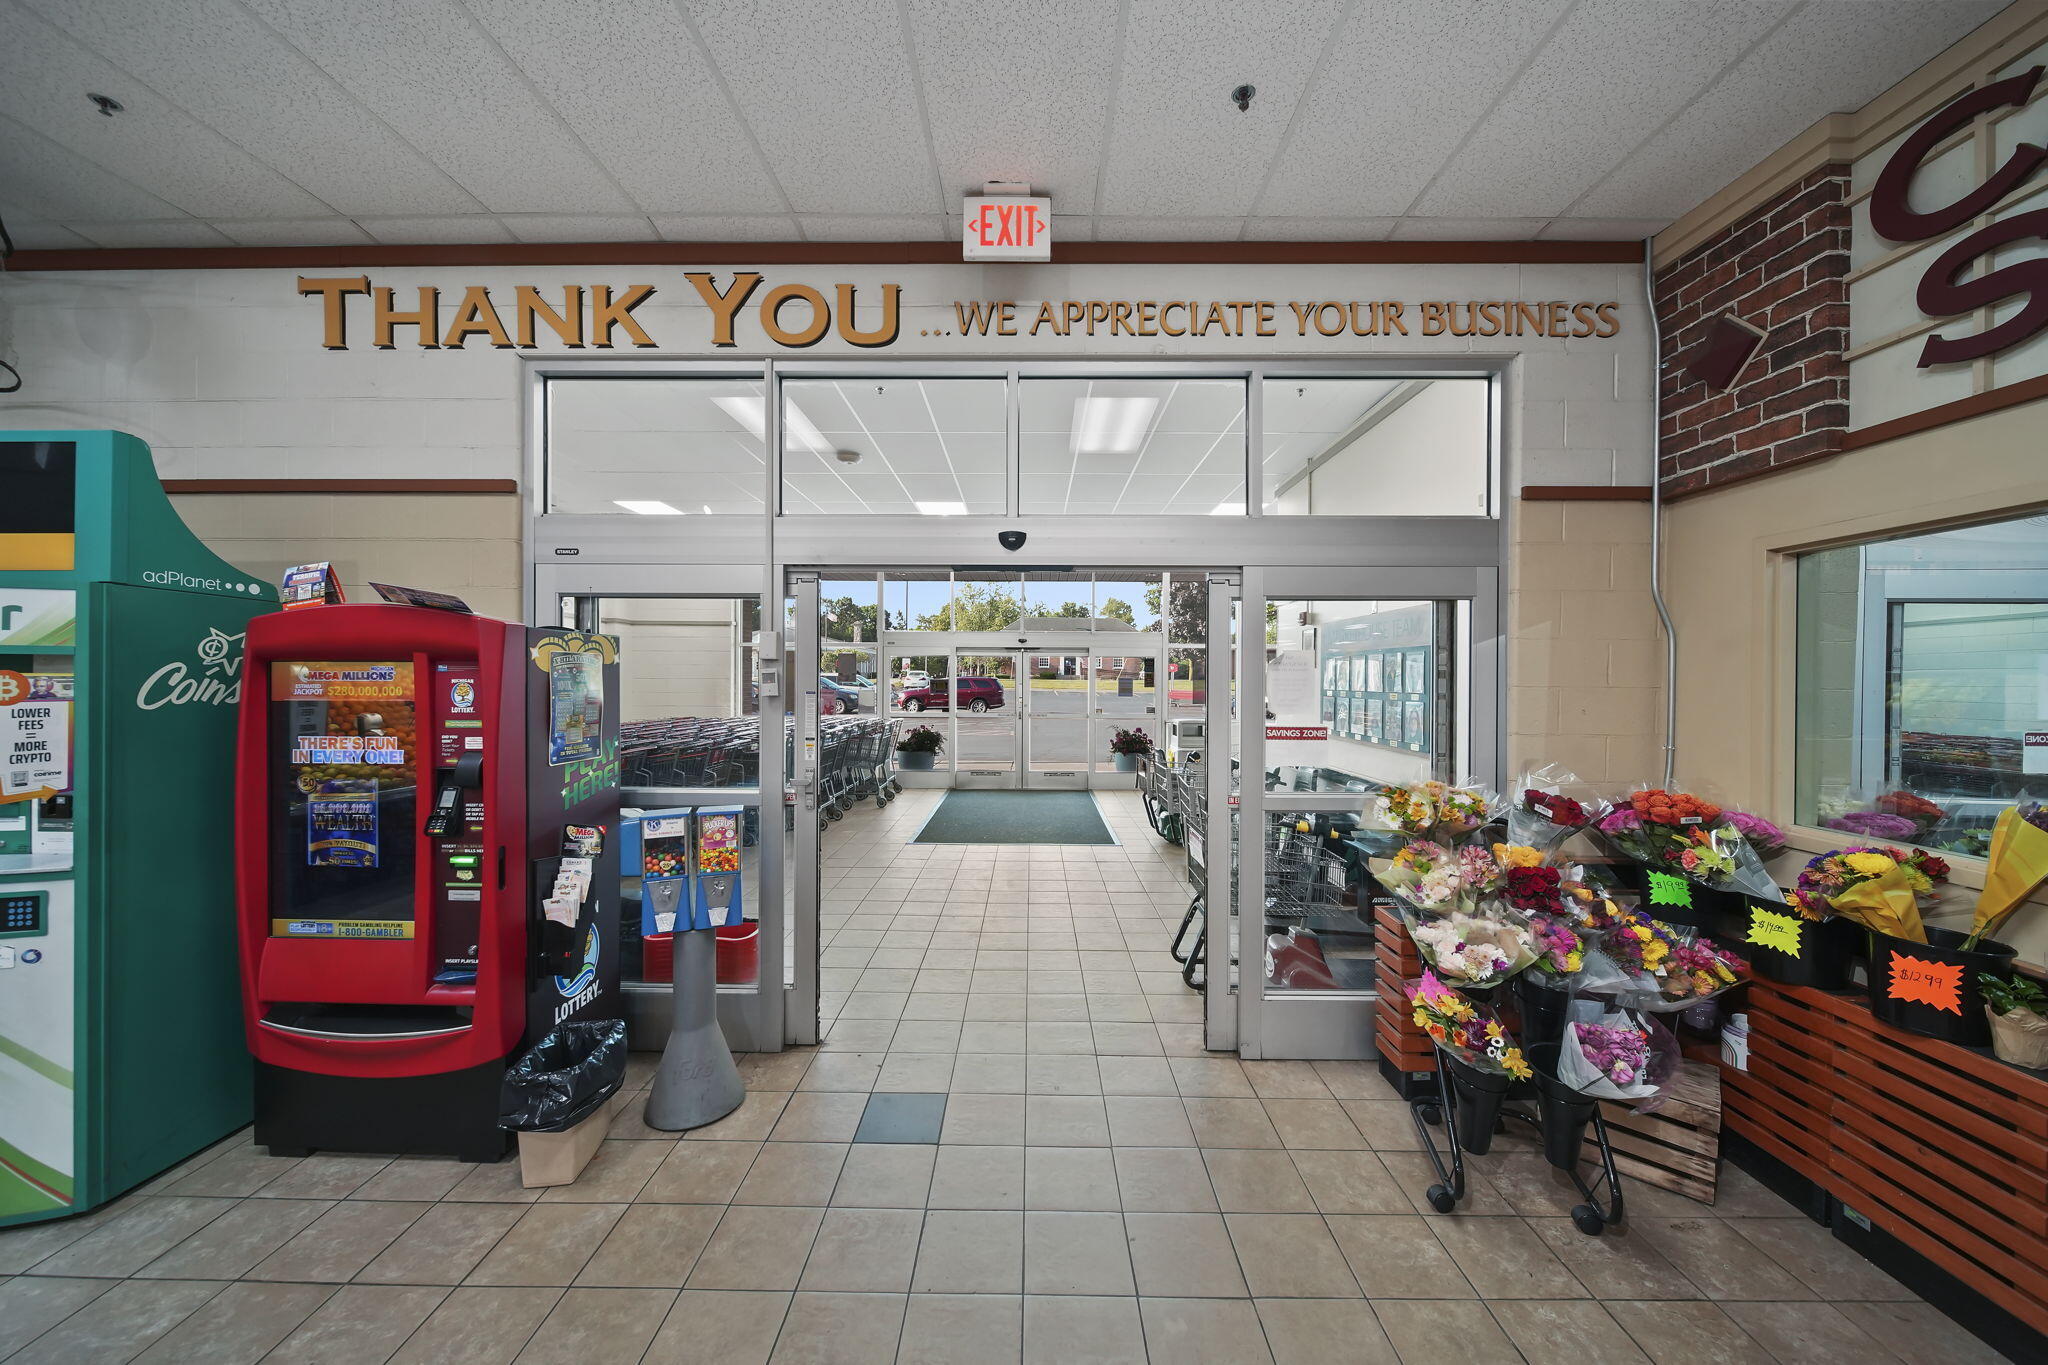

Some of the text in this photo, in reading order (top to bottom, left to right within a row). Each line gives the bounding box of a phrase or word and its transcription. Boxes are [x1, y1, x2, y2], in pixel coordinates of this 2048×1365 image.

[979, 205, 1036, 246] EXIT
[298, 274, 659, 350] THANK
[684, 272, 902, 348] YOU
[1029, 301, 1278, 336] APPRECIATE
[1289, 301, 1408, 336] YOUR
[1420, 301, 1620, 337] BUSINESS
[142, 571, 222, 591] adPlanet
[307, 671, 395, 681] MEGA MILLIONS
[327, 686, 403, 697] $280,000,000
[11, 708, 51, 718] LOWER
[18, 720, 44, 730] FEES
[1266, 729, 1301, 737] SAVINGS
[14, 741, 48, 752] MORE
[298, 736, 398, 751] THERE'S FUN
[9, 752, 52, 764] CRYPTO
[292, 749, 405, 765] IN EVERY ONE!
[313, 814, 375, 830] WEALTH
[555, 978, 600, 1025] LOTTERY
